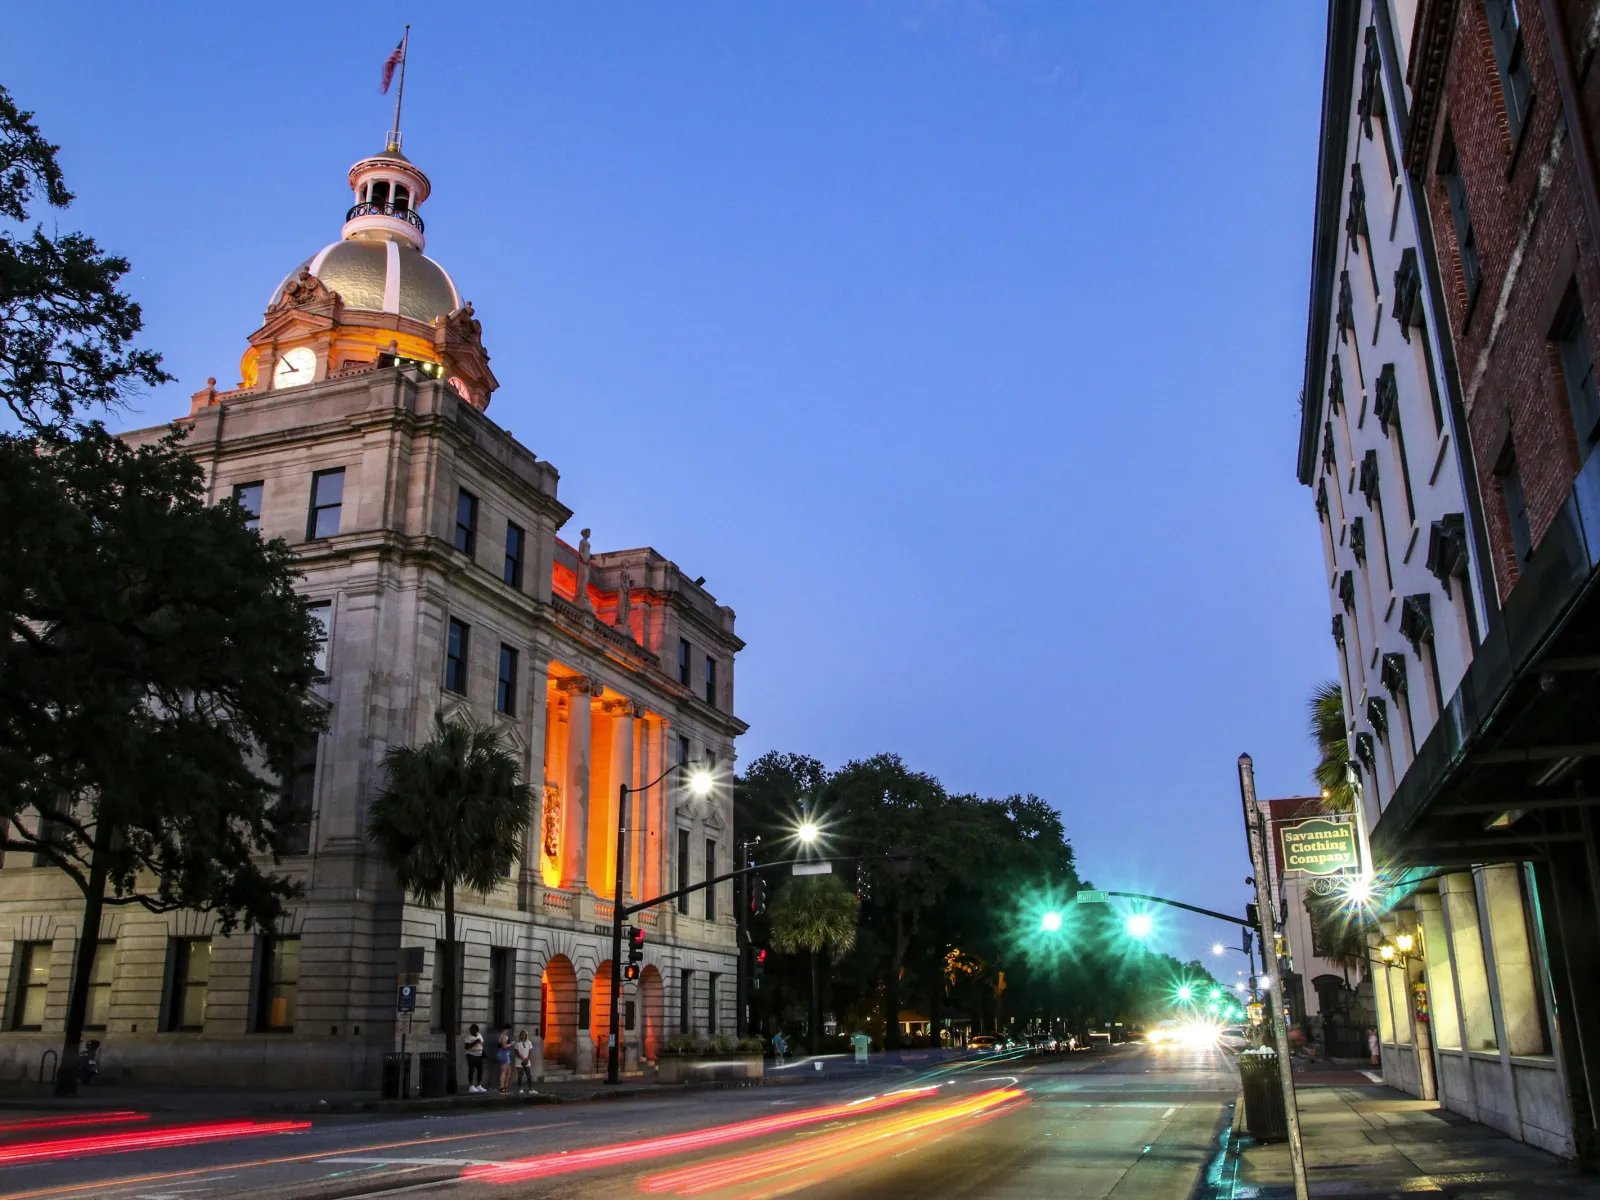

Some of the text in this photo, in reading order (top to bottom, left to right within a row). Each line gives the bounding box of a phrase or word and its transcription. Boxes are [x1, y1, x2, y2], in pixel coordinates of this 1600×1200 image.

[1285, 828, 1349, 842] Savannah
[1291, 840, 1347, 853] Clothing
[1290, 852, 1351, 865] Company
[595, 925, 610, 937] CITY
